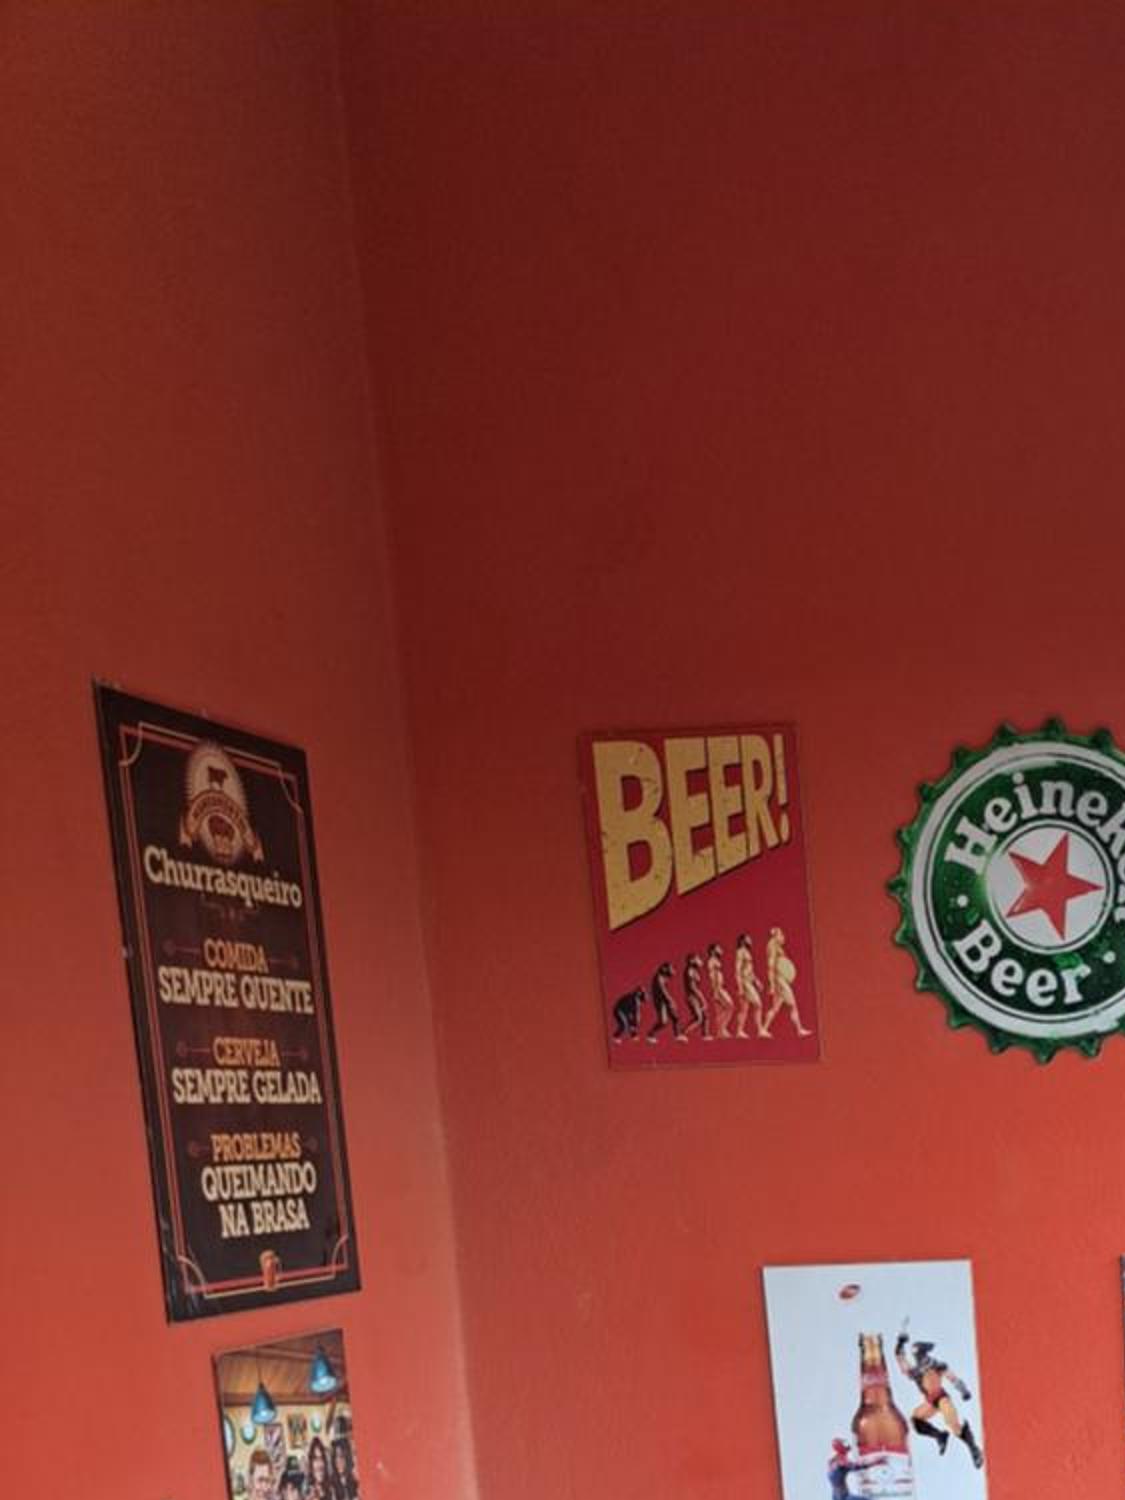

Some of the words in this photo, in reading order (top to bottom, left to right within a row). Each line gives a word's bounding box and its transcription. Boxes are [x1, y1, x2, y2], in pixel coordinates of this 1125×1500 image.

[592, 733, 791, 931] BEER!
[143, 846, 302, 907] Churrasqueiro
[203, 938, 269, 974] COMIDA
[953, 919, 1092, 1007] Beer
[158, 965, 239, 1008] SEMPRE
[240, 974, 314, 1014] QUENTE
[212, 1037, 281, 1067] CERVEJA
[171, 1068, 251, 1104] SEMPRE
[251, 1071, 322, 1104] GELADA
[210, 1132, 301, 1162] PROBLEMAS
[201, 1162, 317, 1202] QUEIMANDO
[219, 1202, 250, 1239] NA
[250, 1198, 310, 1234] BRASA
